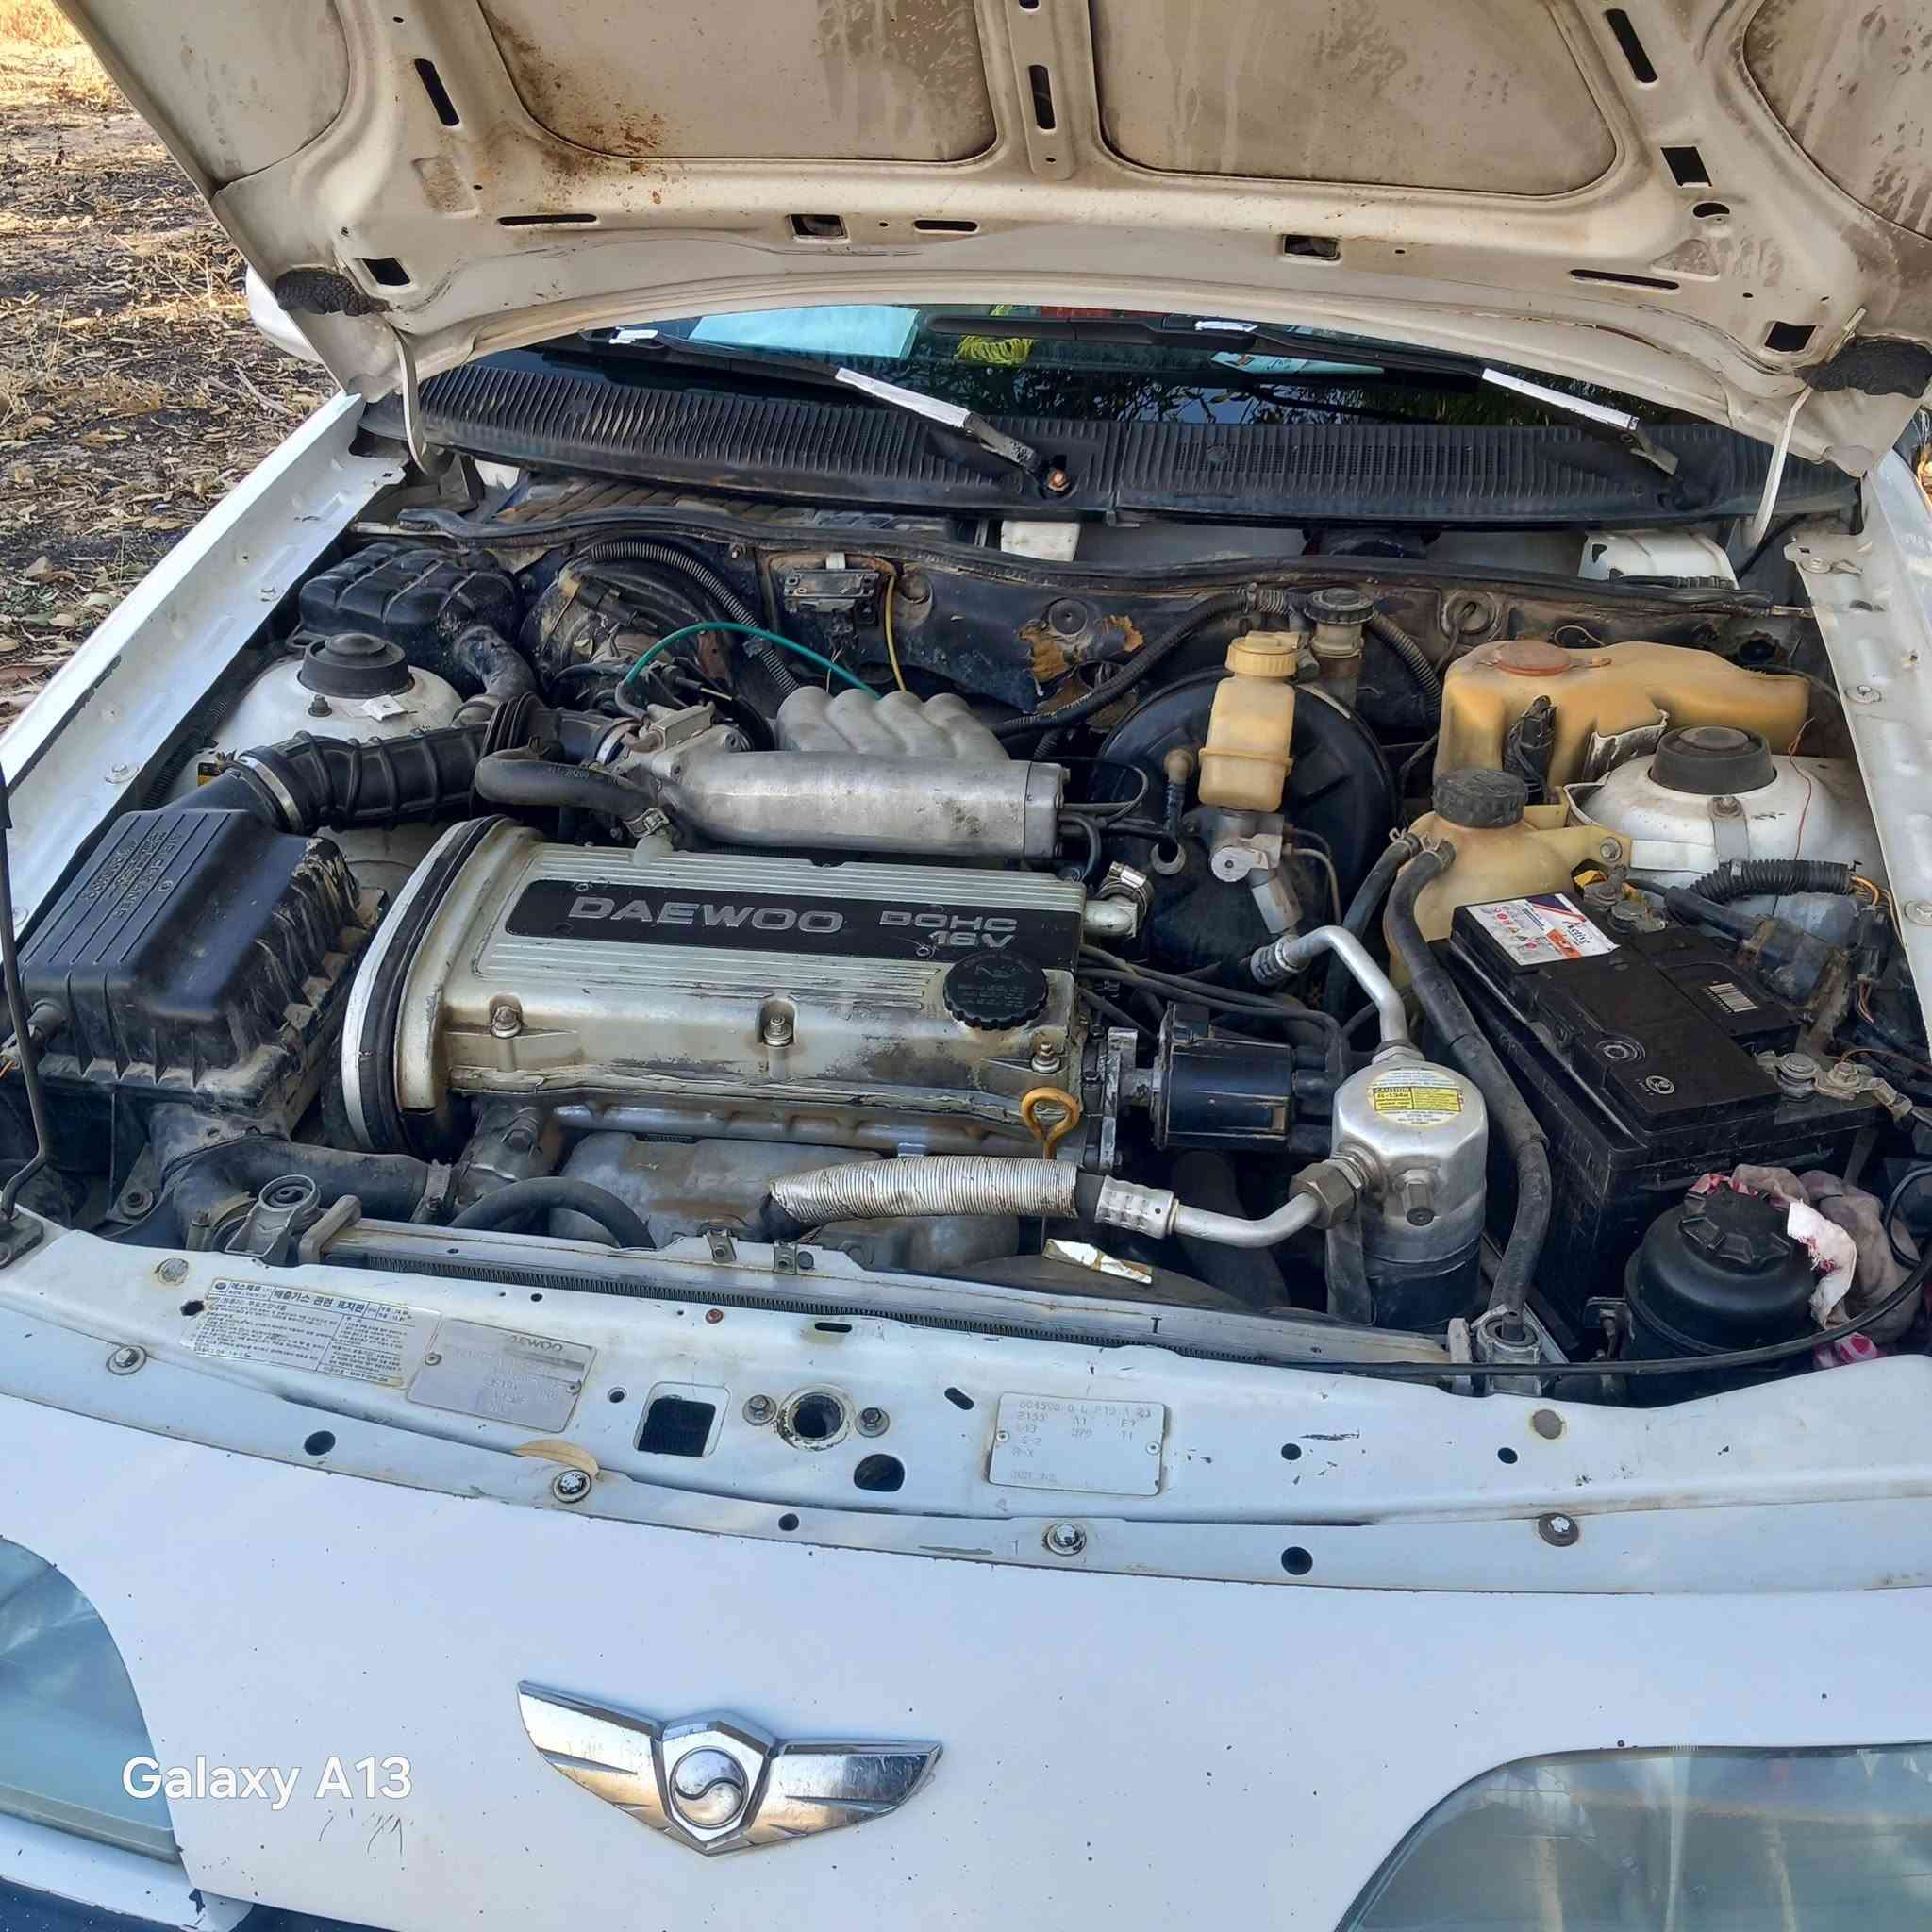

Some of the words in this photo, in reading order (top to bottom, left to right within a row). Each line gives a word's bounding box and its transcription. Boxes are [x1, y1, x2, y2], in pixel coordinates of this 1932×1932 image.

[568, 896, 844, 933] DAEWOO
[879, 910, 1018, 932] DOHC
[928, 929, 1016, 948] 16V
[274, 1289, 310, 1303] 배출가스
[313, 1297, 334, 1307] 관련
[336, 1300, 365, 1313] 표지판
[504, 1331, 564, 1353] AEWOO
